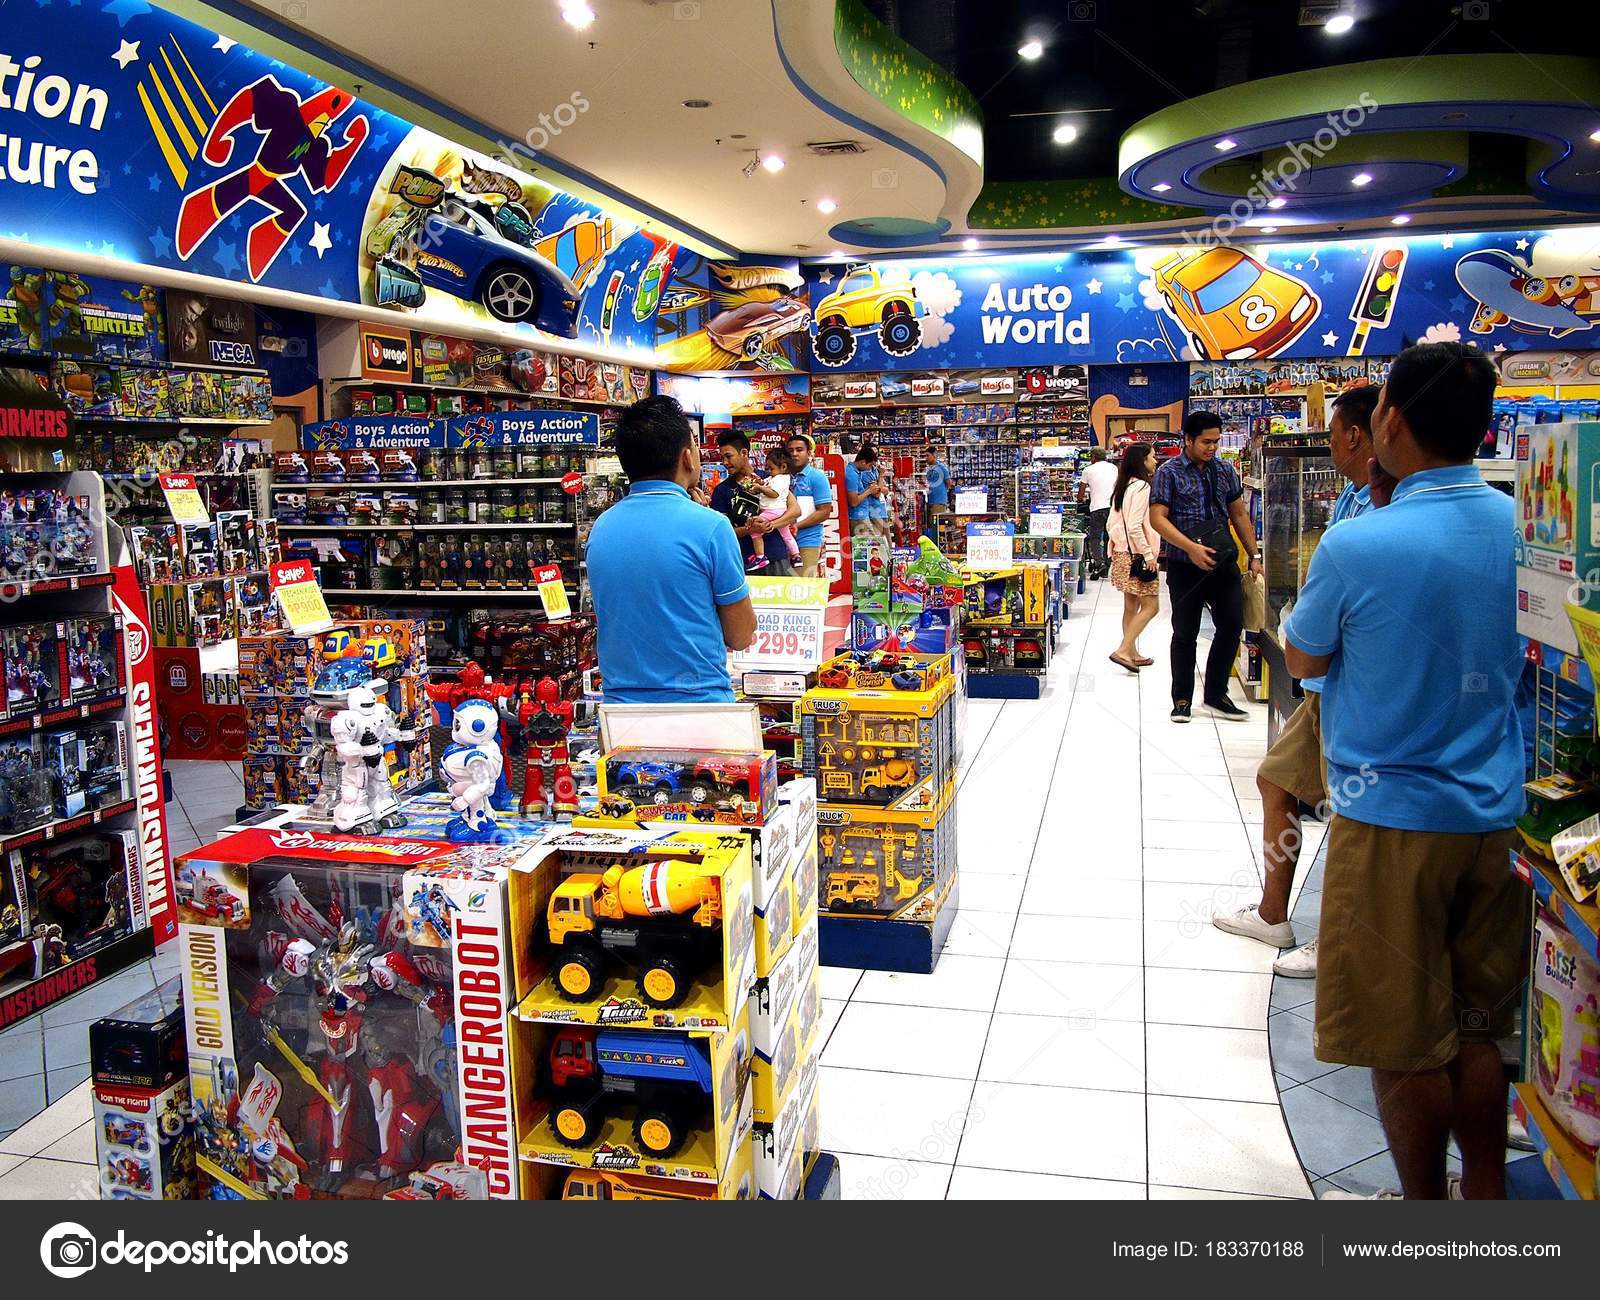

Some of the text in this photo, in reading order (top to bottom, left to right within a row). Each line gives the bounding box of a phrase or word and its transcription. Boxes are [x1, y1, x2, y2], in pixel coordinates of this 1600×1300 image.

[981, 283, 1073, 312] Auto
[1239, 295, 1277, 332] 8
[83, 316, 145, 337] TURTLES
[213, 312, 246, 333] twilight
[980, 312, 1091, 345] World
[209, 340, 255, 364] NECA
[355, 422, 430, 438] Boys Action
[502, 417, 583, 433] Boys Action
[355, 434, 431, 448] & Adventure
[502, 431, 584, 444] & Adventure
[760, 434, 781, 443] Auto
[757, 614, 812, 626] OAD KING
[782, 625, 817, 633] RACER
[812, 700, 842, 710] TRUCK
[663, 812, 688, 822] CAR
[816, 811, 844, 821] TRUCK
[127, 845, 142, 916] TRANSFORMERS
[1545, 964, 1574, 990] Builders
[189, 931, 223, 1049] GOLD VERSION
[456, 918, 511, 1198] CHANGEROBOT
[113, 1095, 126, 1105] THE
